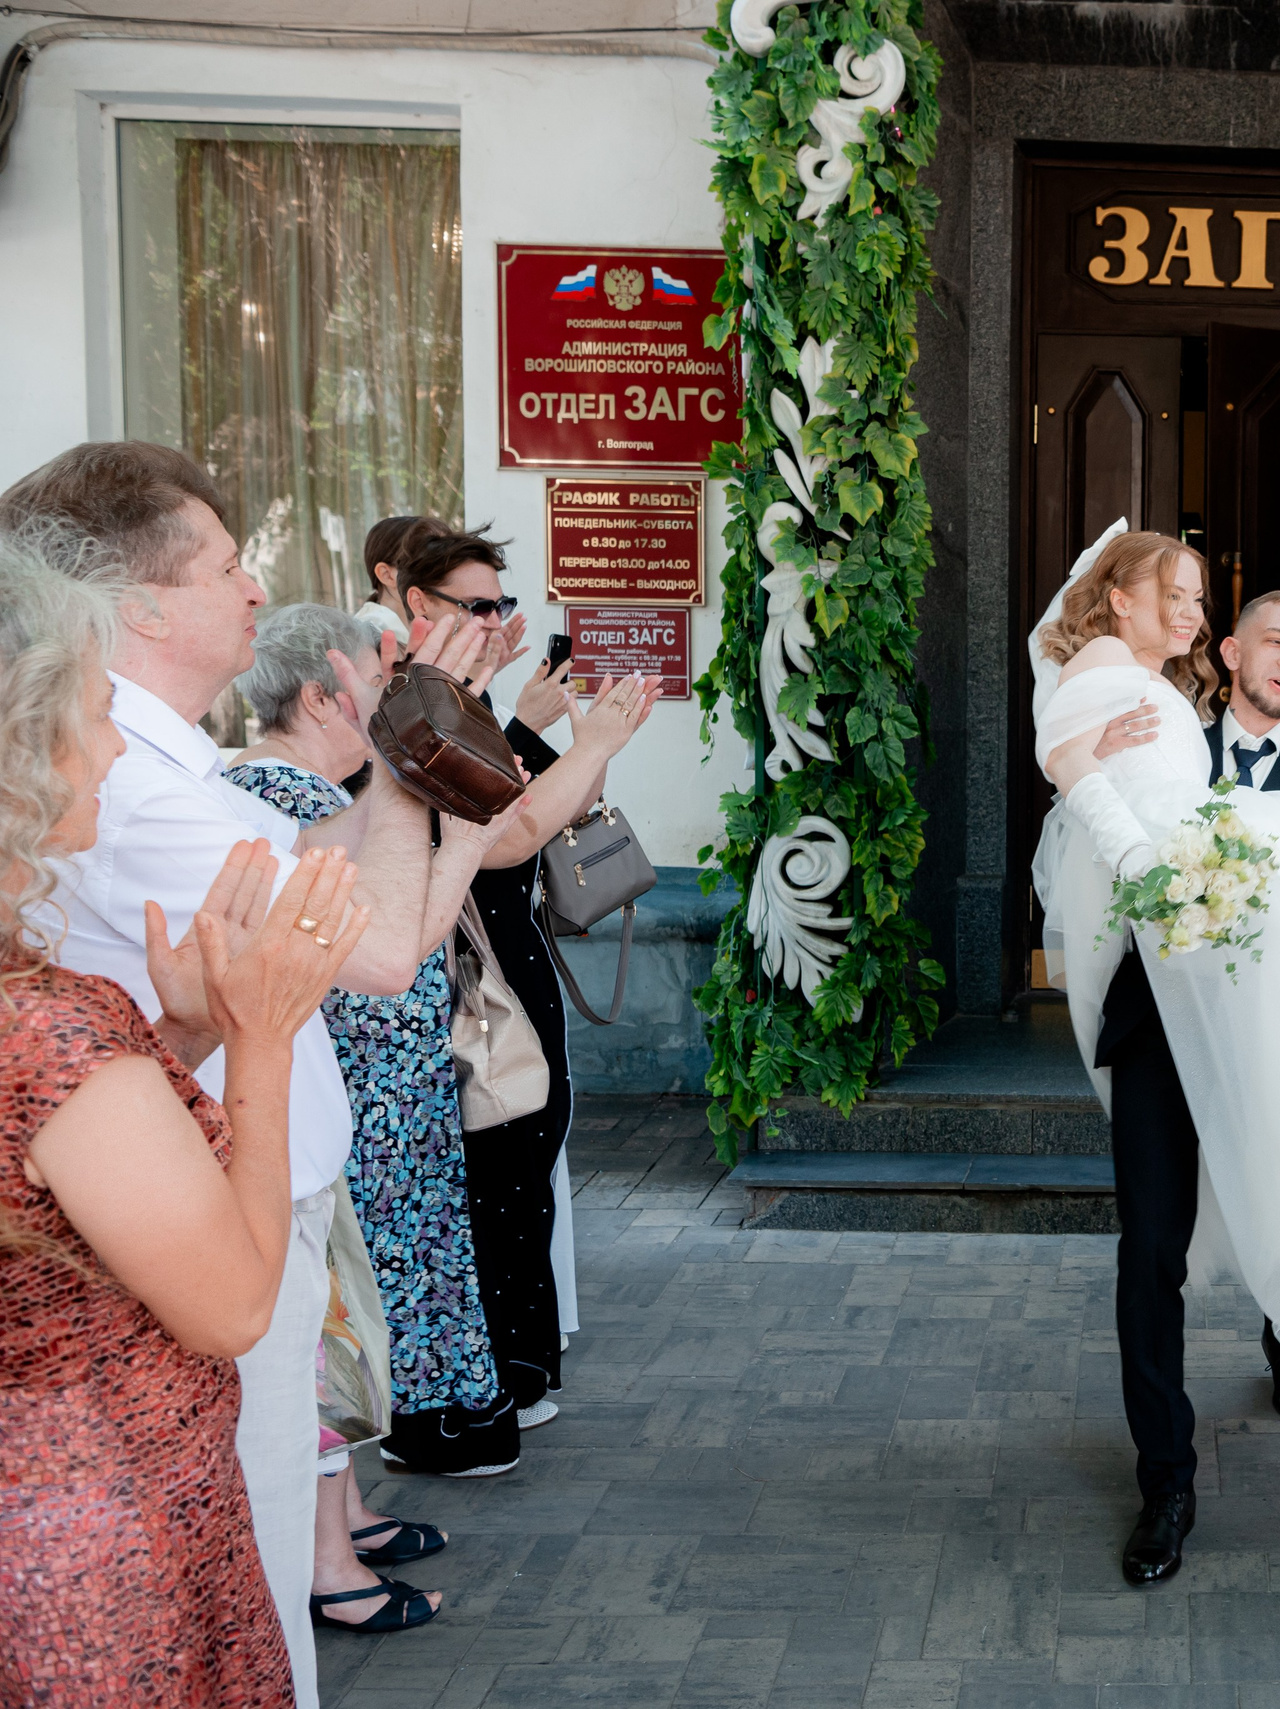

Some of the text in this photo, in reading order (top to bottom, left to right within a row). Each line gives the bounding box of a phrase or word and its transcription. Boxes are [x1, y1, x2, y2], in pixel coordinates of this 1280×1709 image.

[566, 318, 682, 331] РОССИЙСКАЯ ФЕДЕРАЦИЯ
[561, 341, 687, 358] АДМИНИСТРАЦИЯ
[524, 358, 725, 376] ВОРОШИЛОВСКОГО РАЙОНА
[519, 385, 726, 424] ОТДЕЛ ЗАГС
[598, 438, 654, 451] г. Волгоград
[553, 491, 695, 507] ГРАФИК РАБОТЫ
[582, 537, 666, 549] с 8.30 до 17.30
[559, 557, 609, 568] ПЕРЕРЫВ
[554, 577, 627, 589] ВОСКРЕСЕНЬЕ
[637, 578, 696, 591] ВЫХОДНОЙ
[597, 611, 658, 619] АДМИНИСТРАЦИЯ
[579, 618, 676, 627] ВОРОШИЛОВСКОГО РАЙОНА
[580, 627, 676, 646] ОТДЕЛ ЗАГС
